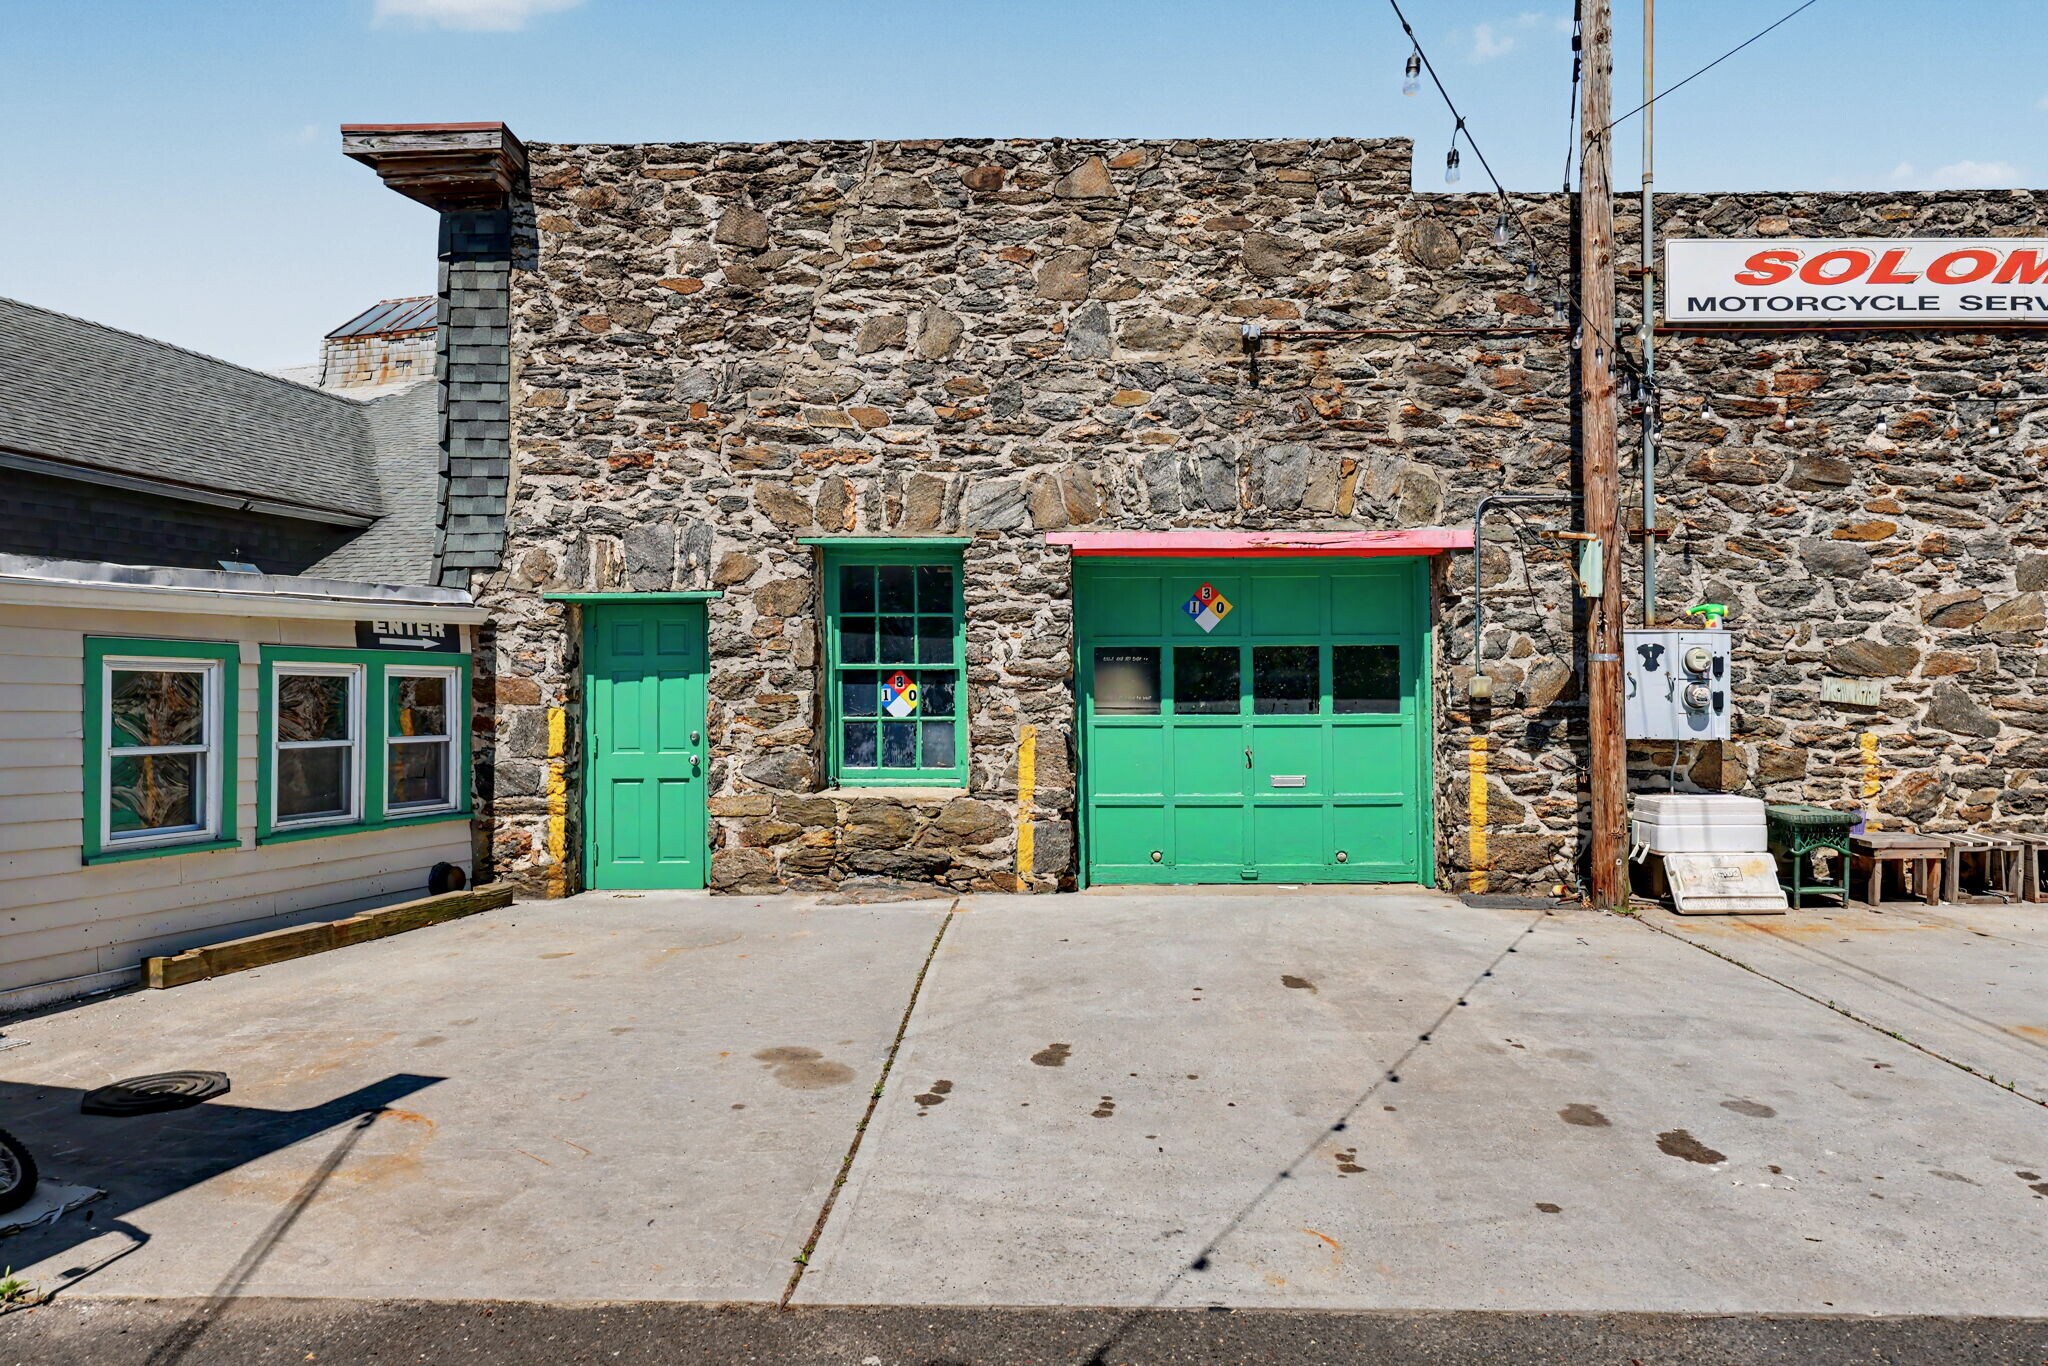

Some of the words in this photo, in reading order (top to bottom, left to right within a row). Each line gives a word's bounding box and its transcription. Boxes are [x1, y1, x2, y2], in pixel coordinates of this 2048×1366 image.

[1687, 296, 1939, 312] MOTORCYCLE
[1203, 588, 1210, 599] 3
[1216, 602, 1224, 613] 0
[372, 620, 446, 637] ENTER
[883, 690, 889, 701] 1
[909, 690, 916, 701] 0
